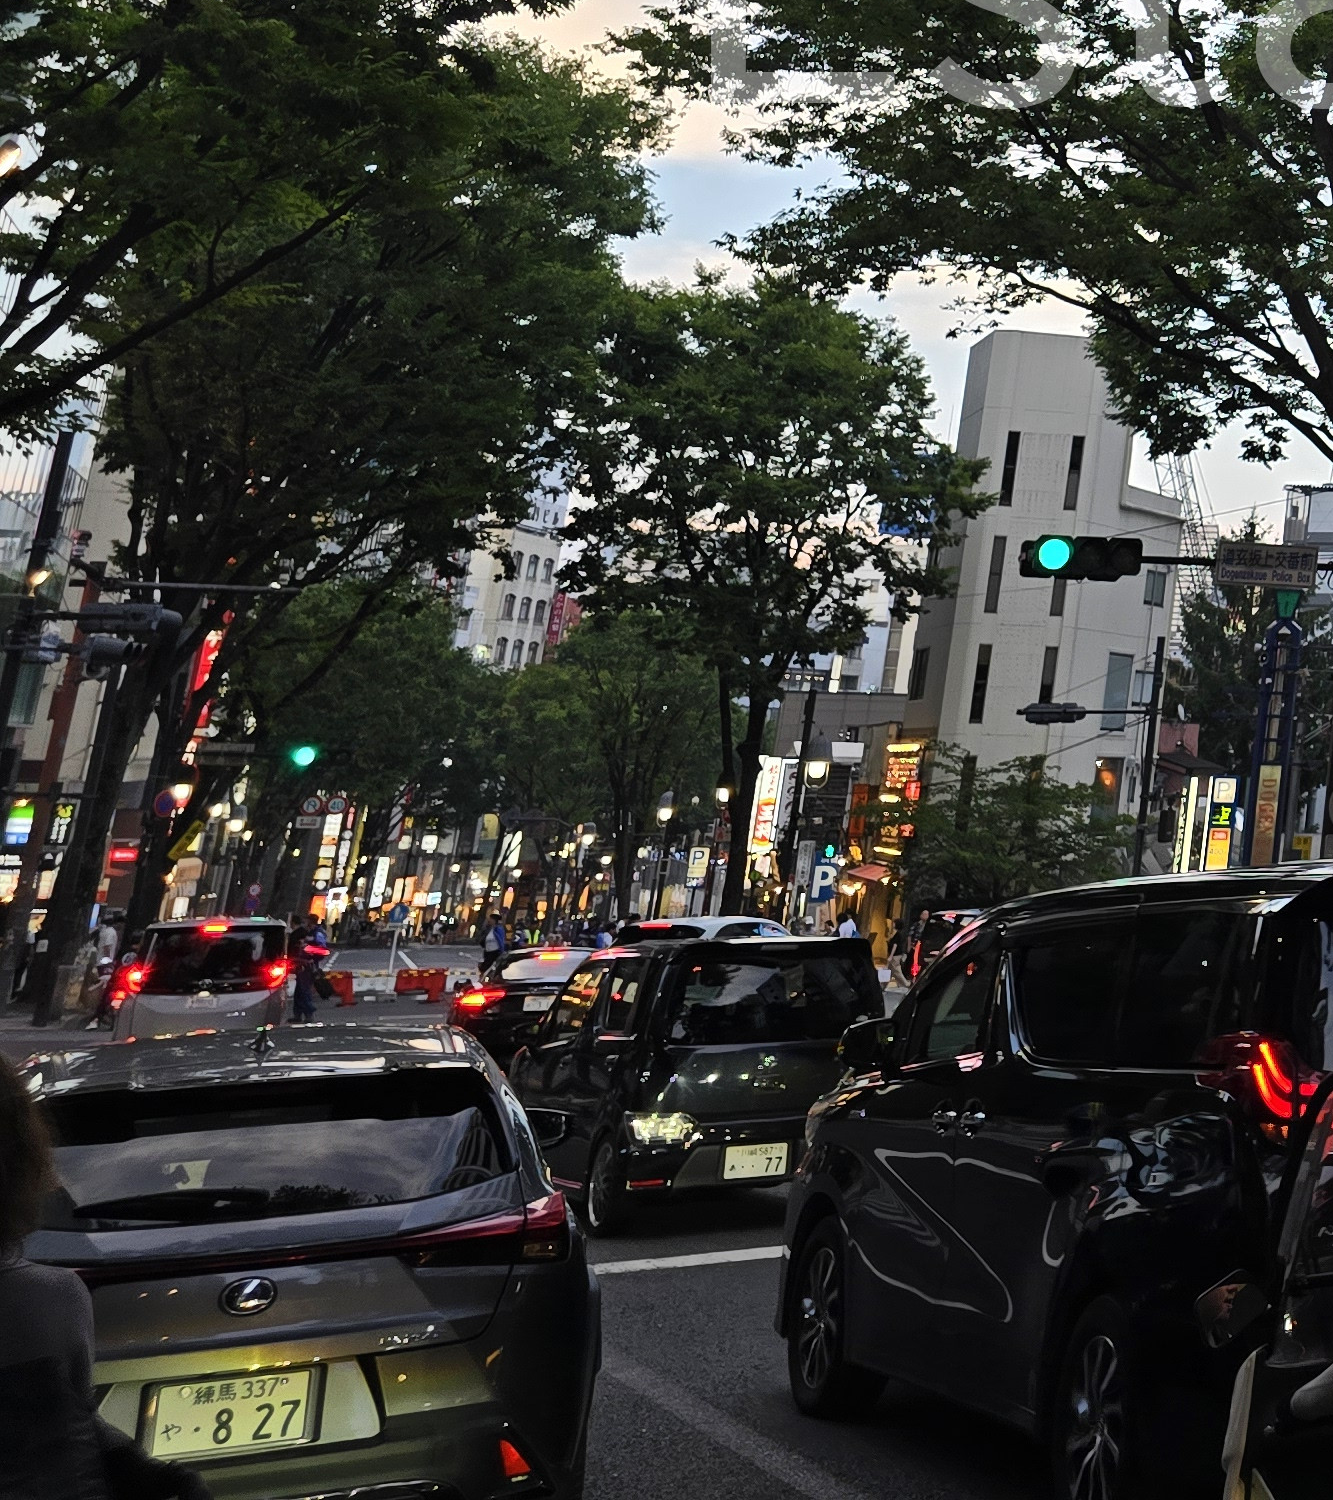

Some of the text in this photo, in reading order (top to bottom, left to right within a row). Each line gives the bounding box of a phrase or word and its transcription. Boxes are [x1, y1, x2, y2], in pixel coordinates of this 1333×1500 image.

[1222, 548, 1315, 571] 道玄坂上交番前
[1271, 569, 1293, 583] Police
[1297, 571, 1311, 583] Box
[1217, 781, 1231, 799] P
[329, 800, 345, 811] 40
[691, 850, 705, 865] P
[811, 865, 838, 899] P
[764, 1156, 783, 1173] 77
[192, 1377, 280, 1405] 練馬 337
[160, 1423, 182, 1442] や
